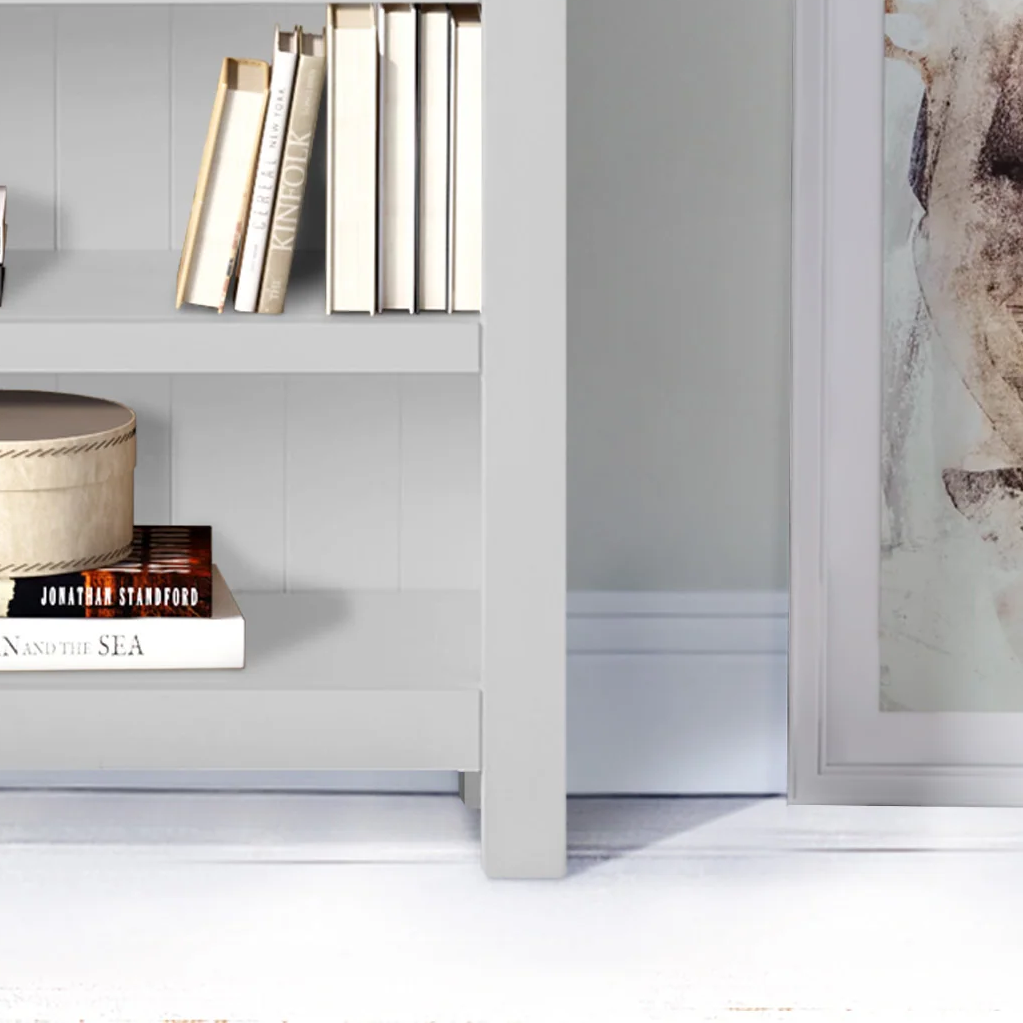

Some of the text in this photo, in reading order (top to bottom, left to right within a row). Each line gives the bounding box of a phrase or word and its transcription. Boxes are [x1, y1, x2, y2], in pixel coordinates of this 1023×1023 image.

[274, 88, 286, 118] YORK
[269, 123, 280, 149] NEW
[252, 160, 277, 230] CEREAL
[271, 130, 312, 251] KINFOLK
[40, 586, 199, 607] JONATHAN STANDFORD
[23, 641, 57, 656] AND
[59, 641, 92, 656] THE
[98, 634, 145, 658] SEA
